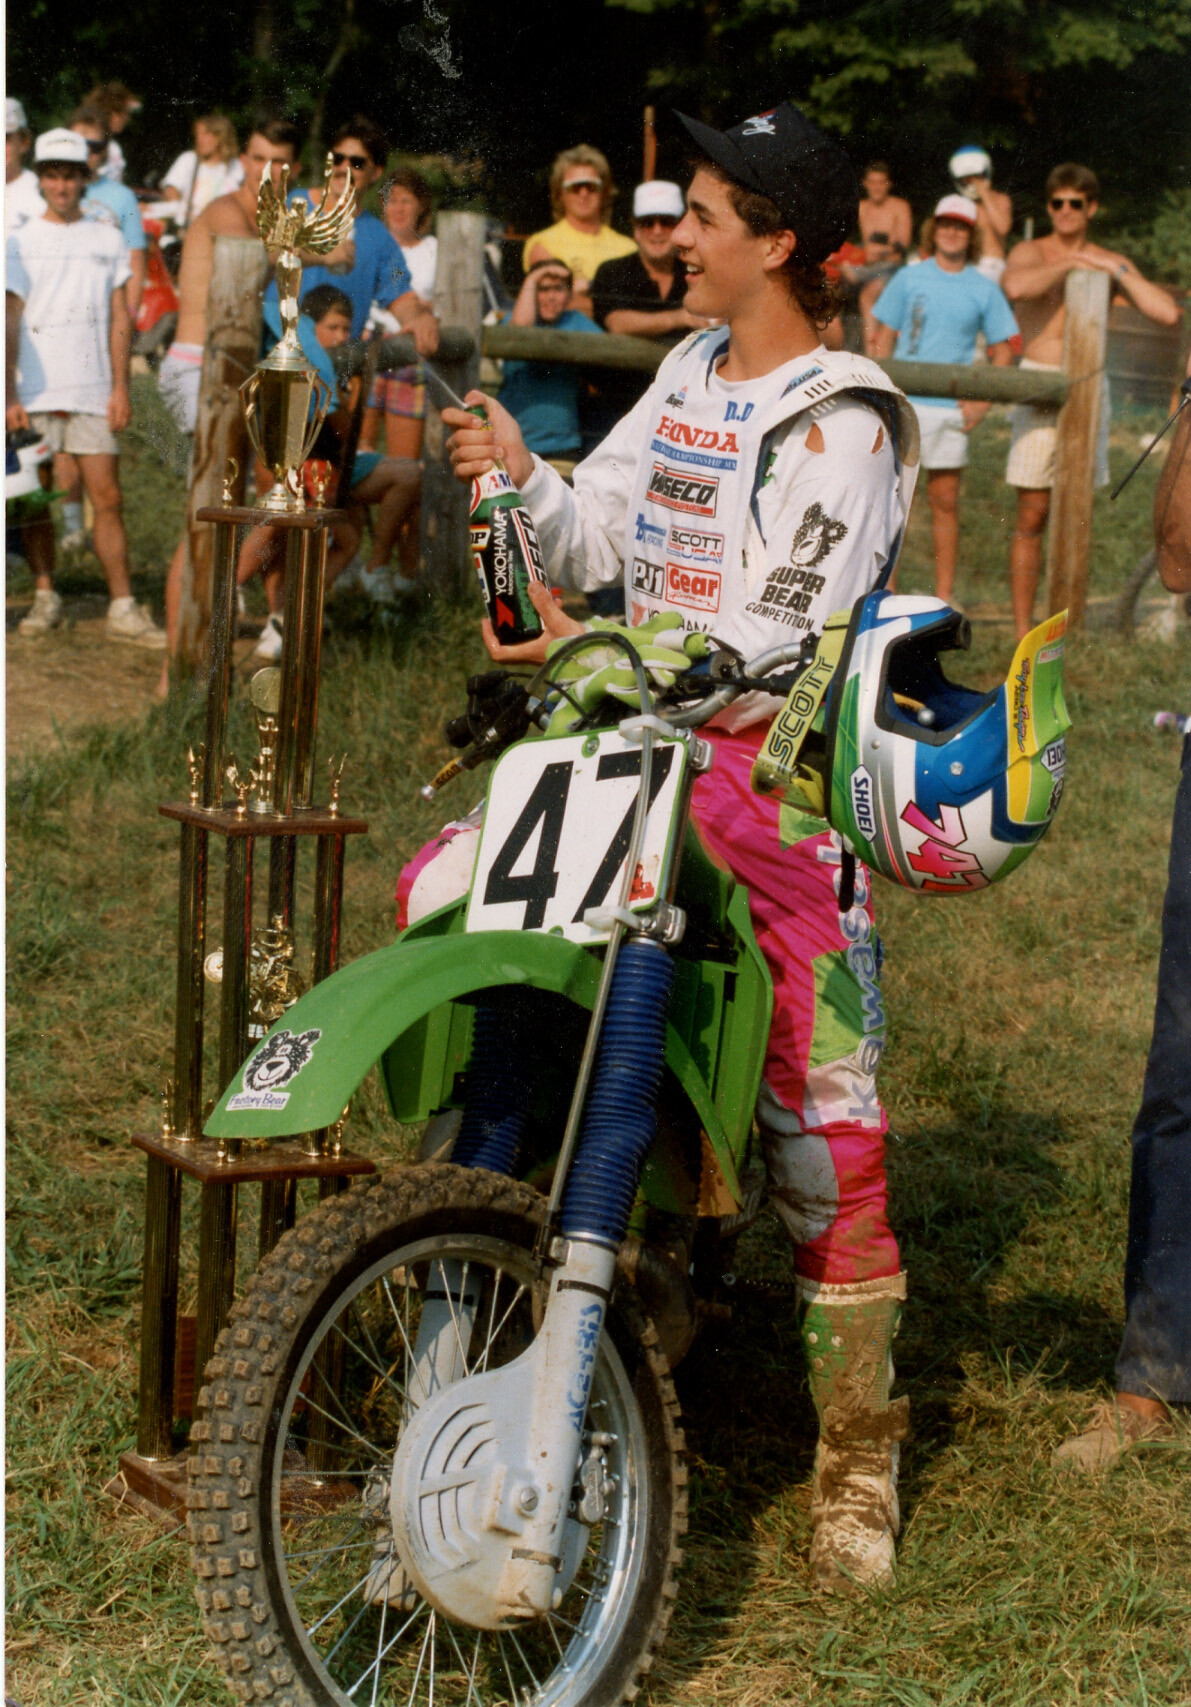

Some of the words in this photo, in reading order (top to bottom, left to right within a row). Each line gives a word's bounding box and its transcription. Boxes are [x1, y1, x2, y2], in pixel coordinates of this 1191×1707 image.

[494, 512, 508, 596] YOKOHAMA
[671, 530, 722, 550] SCOTT
[632, 562, 663, 597] PJ1
[669, 568, 718, 598] Gear
[766, 566, 826, 595] SUPER
[760, 584, 813, 614] BEAR
[768, 654, 836, 775] SCOTT
[853, 776, 873, 833] SHOEI
[483, 745, 676, 930] 47
[817, 828, 885, 1128] Kawasak
[231, 1094, 261, 1107] Factory
[262, 1093, 287, 1106] Bear
